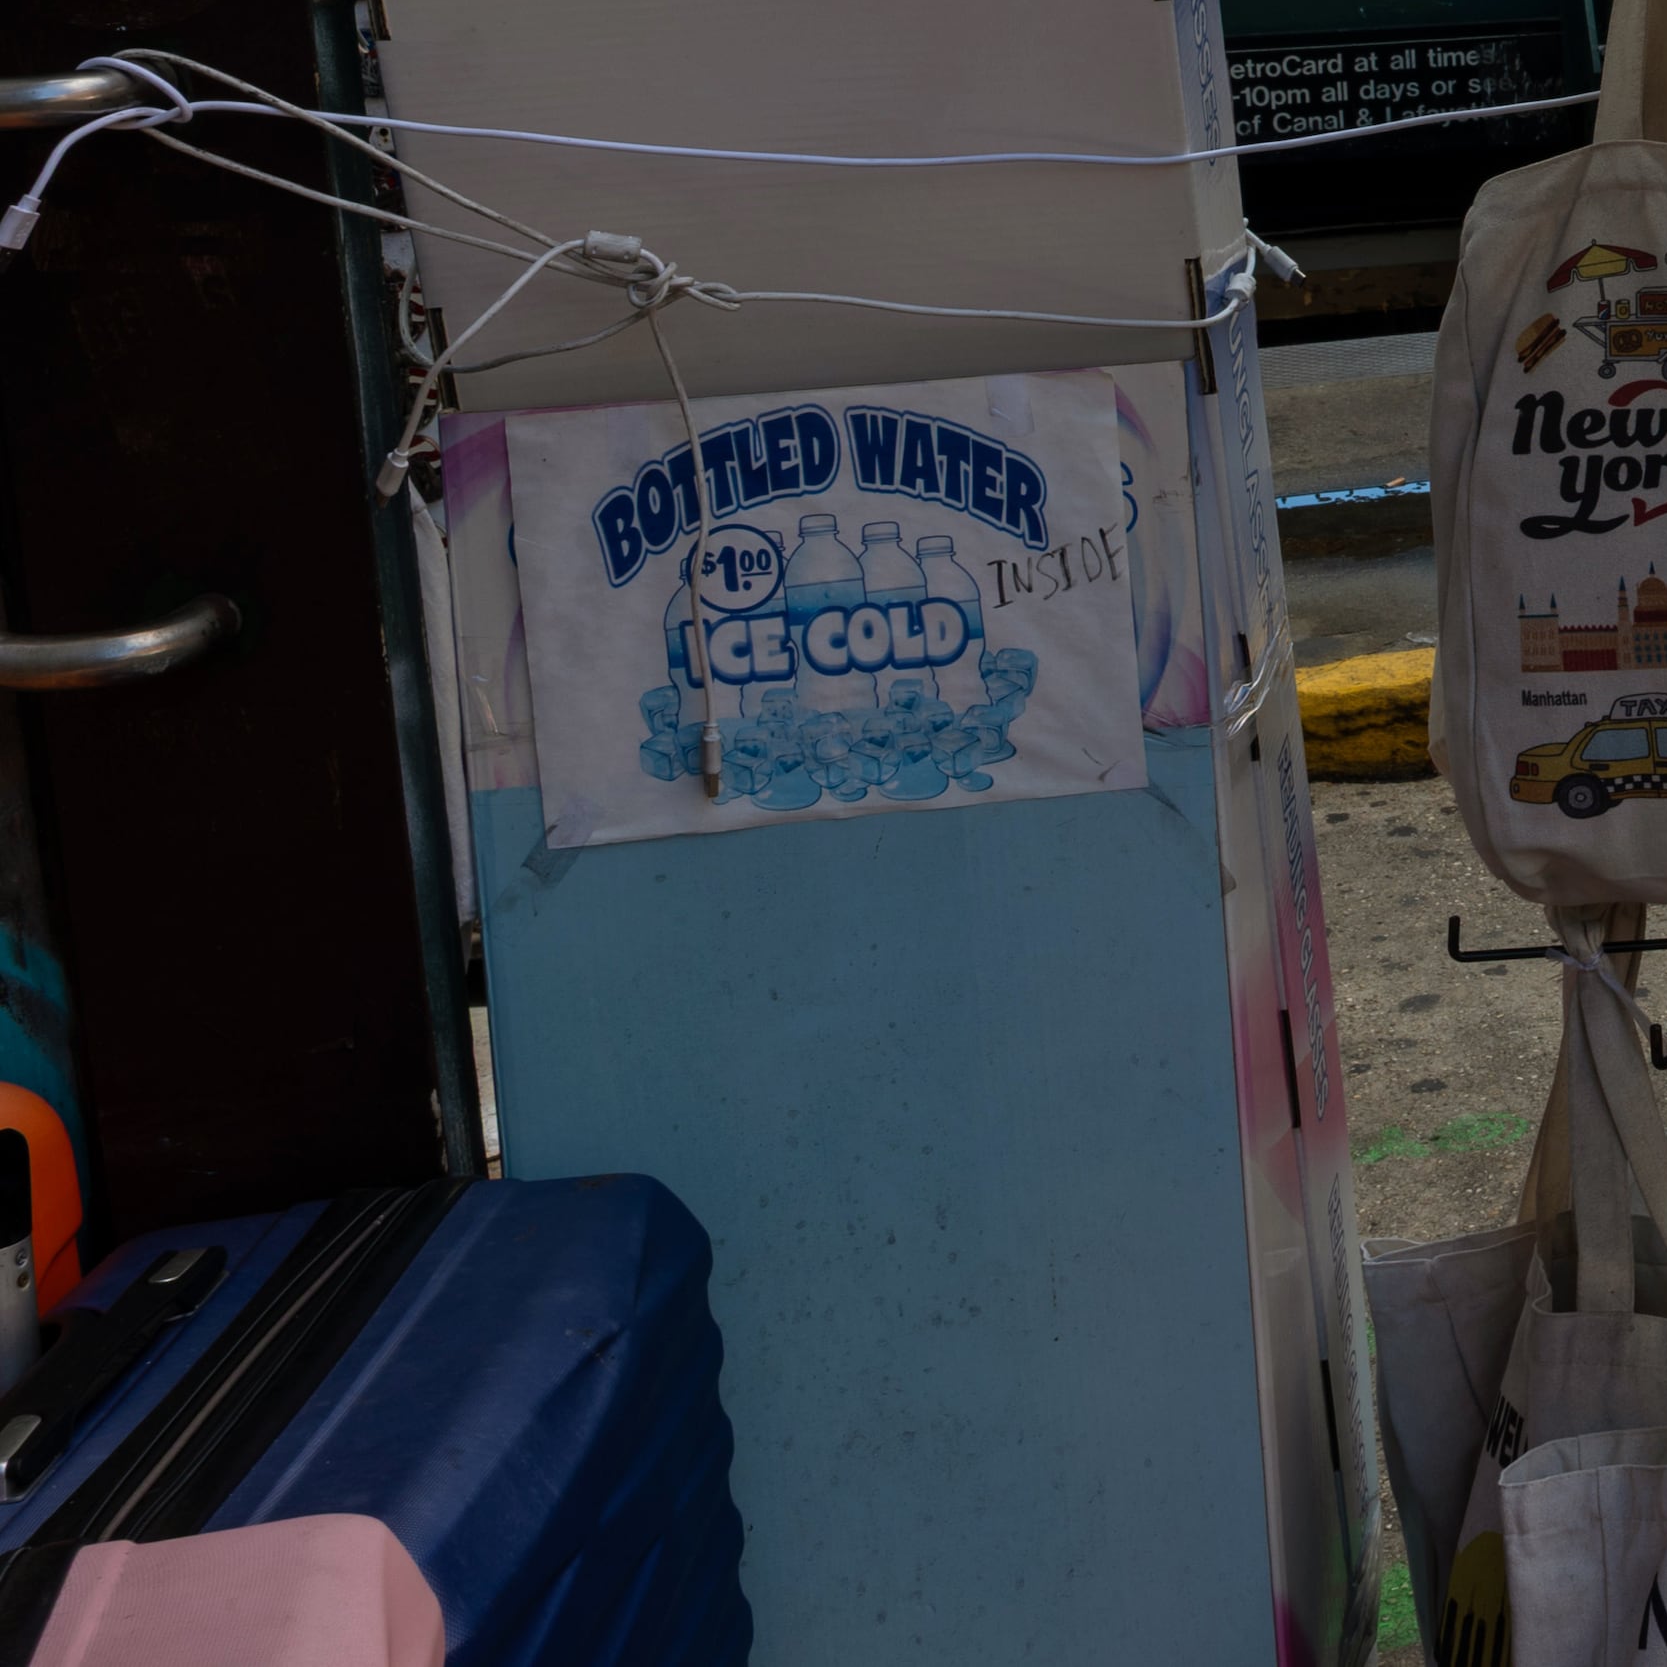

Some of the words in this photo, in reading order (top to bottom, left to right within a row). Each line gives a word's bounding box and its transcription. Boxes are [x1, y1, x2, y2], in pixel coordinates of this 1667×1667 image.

[1230, 55, 1343, 80] etroCard
[1354, 50, 1379, 72] at
[1390, 48, 1417, 70] all
[1321, 81, 1349, 104] all
[1358, 79, 1421, 104] days
[1431, 75, 1457, 96] or
[1236, 113, 1262, 136] of
[1271, 109, 1346, 135] Canal
[1355, 107, 1375, 129] &
[593, 404, 839, 587] BOTTLED
[845, 406, 1048, 550] WATER
[986, 521, 1131, 610] INSIDE
[681, 611, 799, 688] ICE
[802, 598, 969, 676] COLD
[1520, 688, 1588, 708] Manhattan
[1277, 733, 1308, 930] READING
[1301, 926, 1330, 1120] GLASSES
